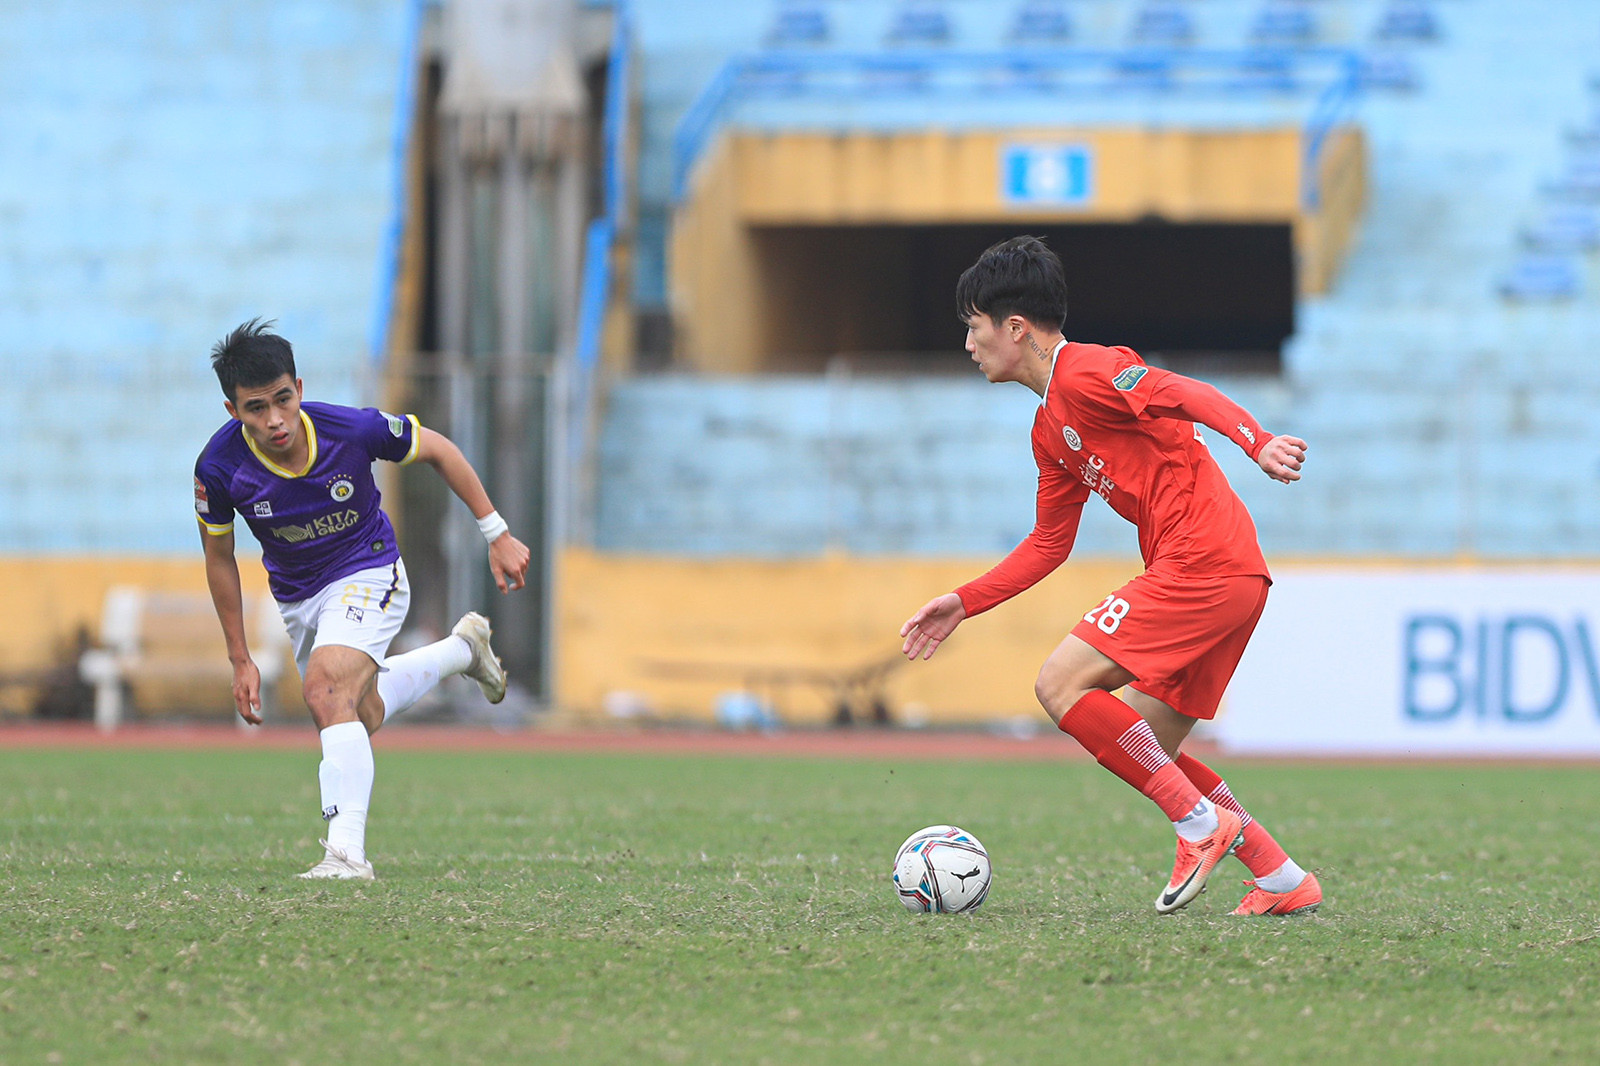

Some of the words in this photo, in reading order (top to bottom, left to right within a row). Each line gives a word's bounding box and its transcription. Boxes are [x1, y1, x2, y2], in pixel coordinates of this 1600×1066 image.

[313, 508, 358, 530] KITA
[318, 515, 360, 536] GROUP
[341, 583, 371, 608] 21
[1083, 594, 1131, 635] 28
